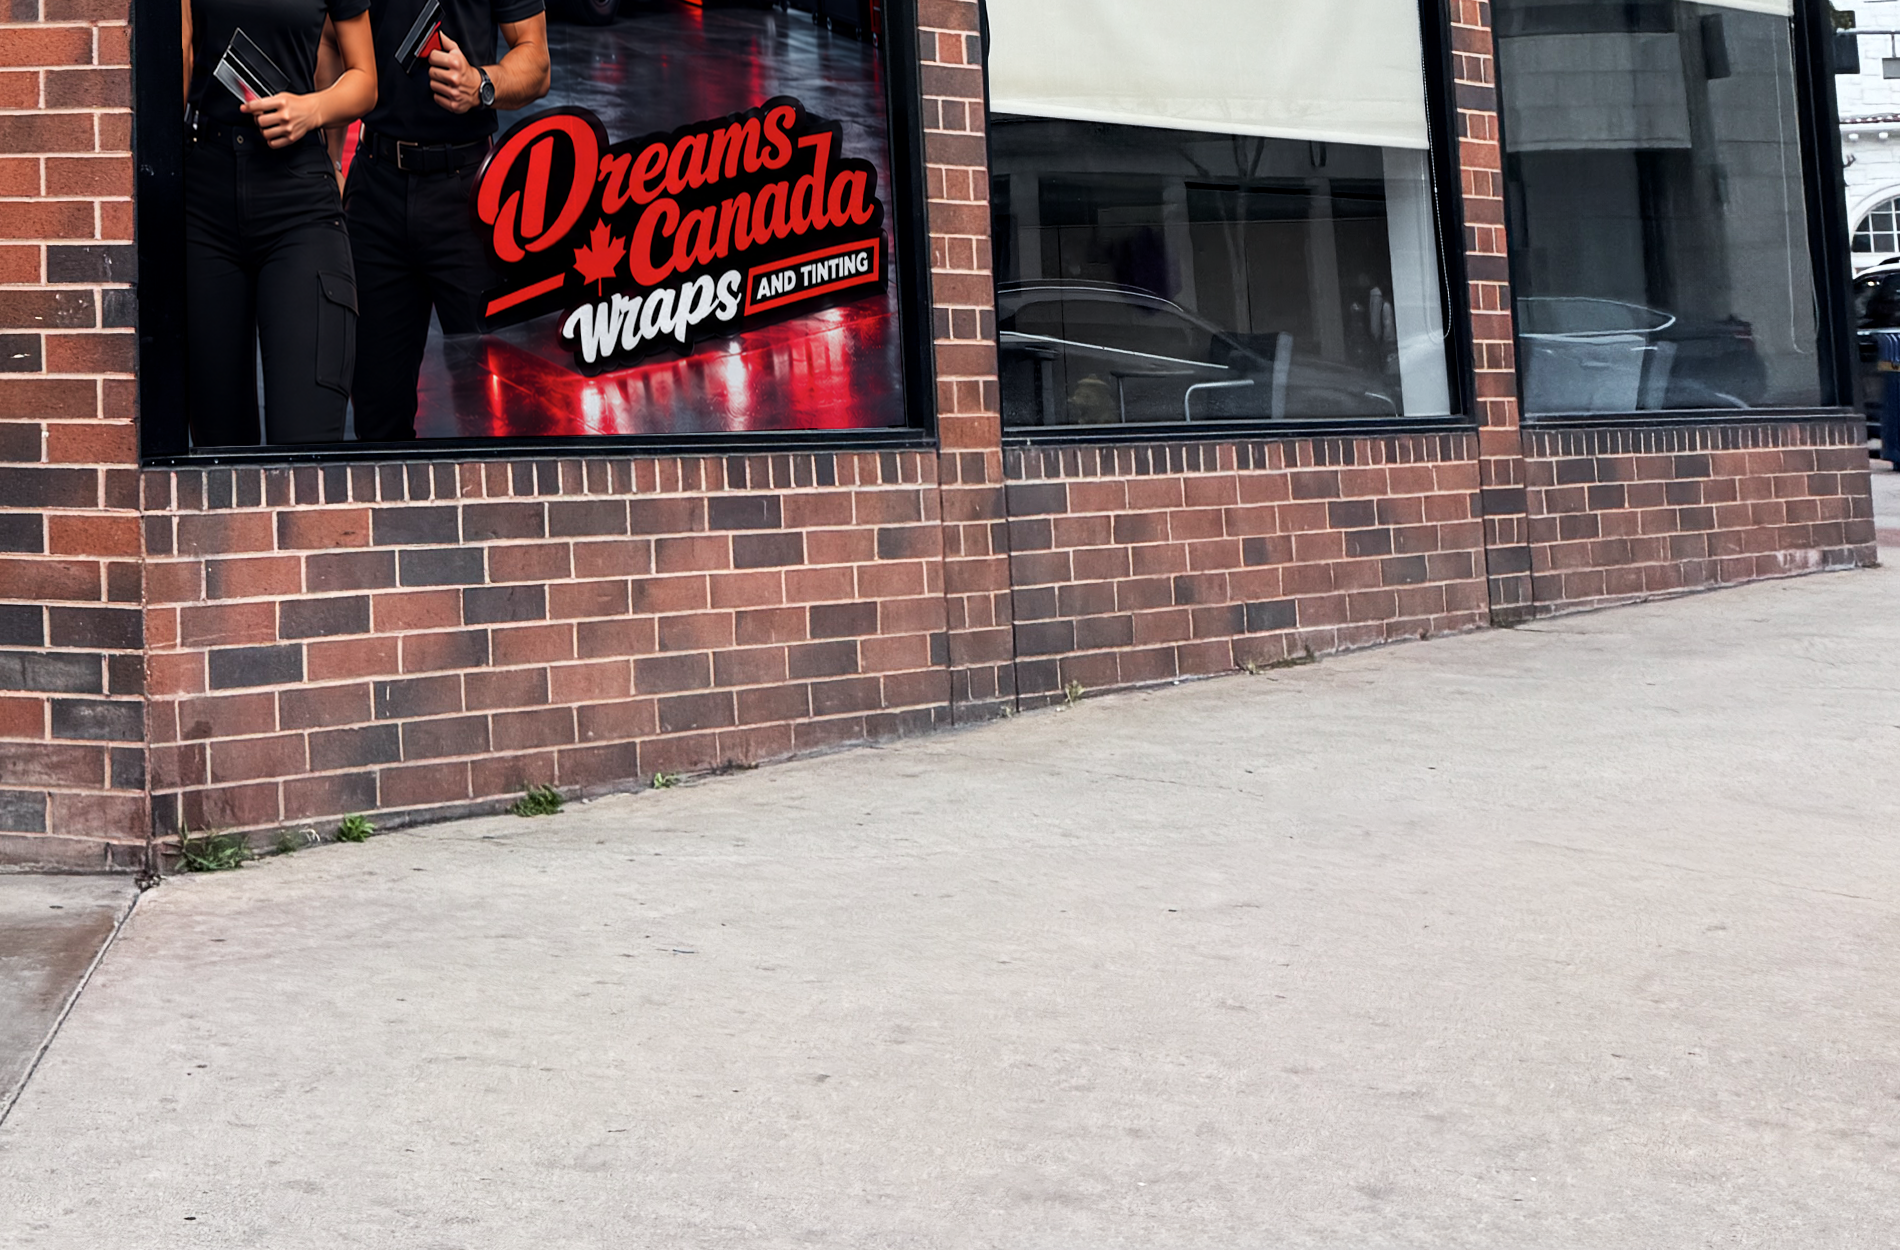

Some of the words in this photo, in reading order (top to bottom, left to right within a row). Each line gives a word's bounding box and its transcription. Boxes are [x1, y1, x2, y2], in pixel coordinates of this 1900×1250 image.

[477, 105, 797, 263] Dreams
[629, 131, 875, 286] Canada
[756, 270, 797, 300] AND
[800, 251, 869, 288] TINTING
